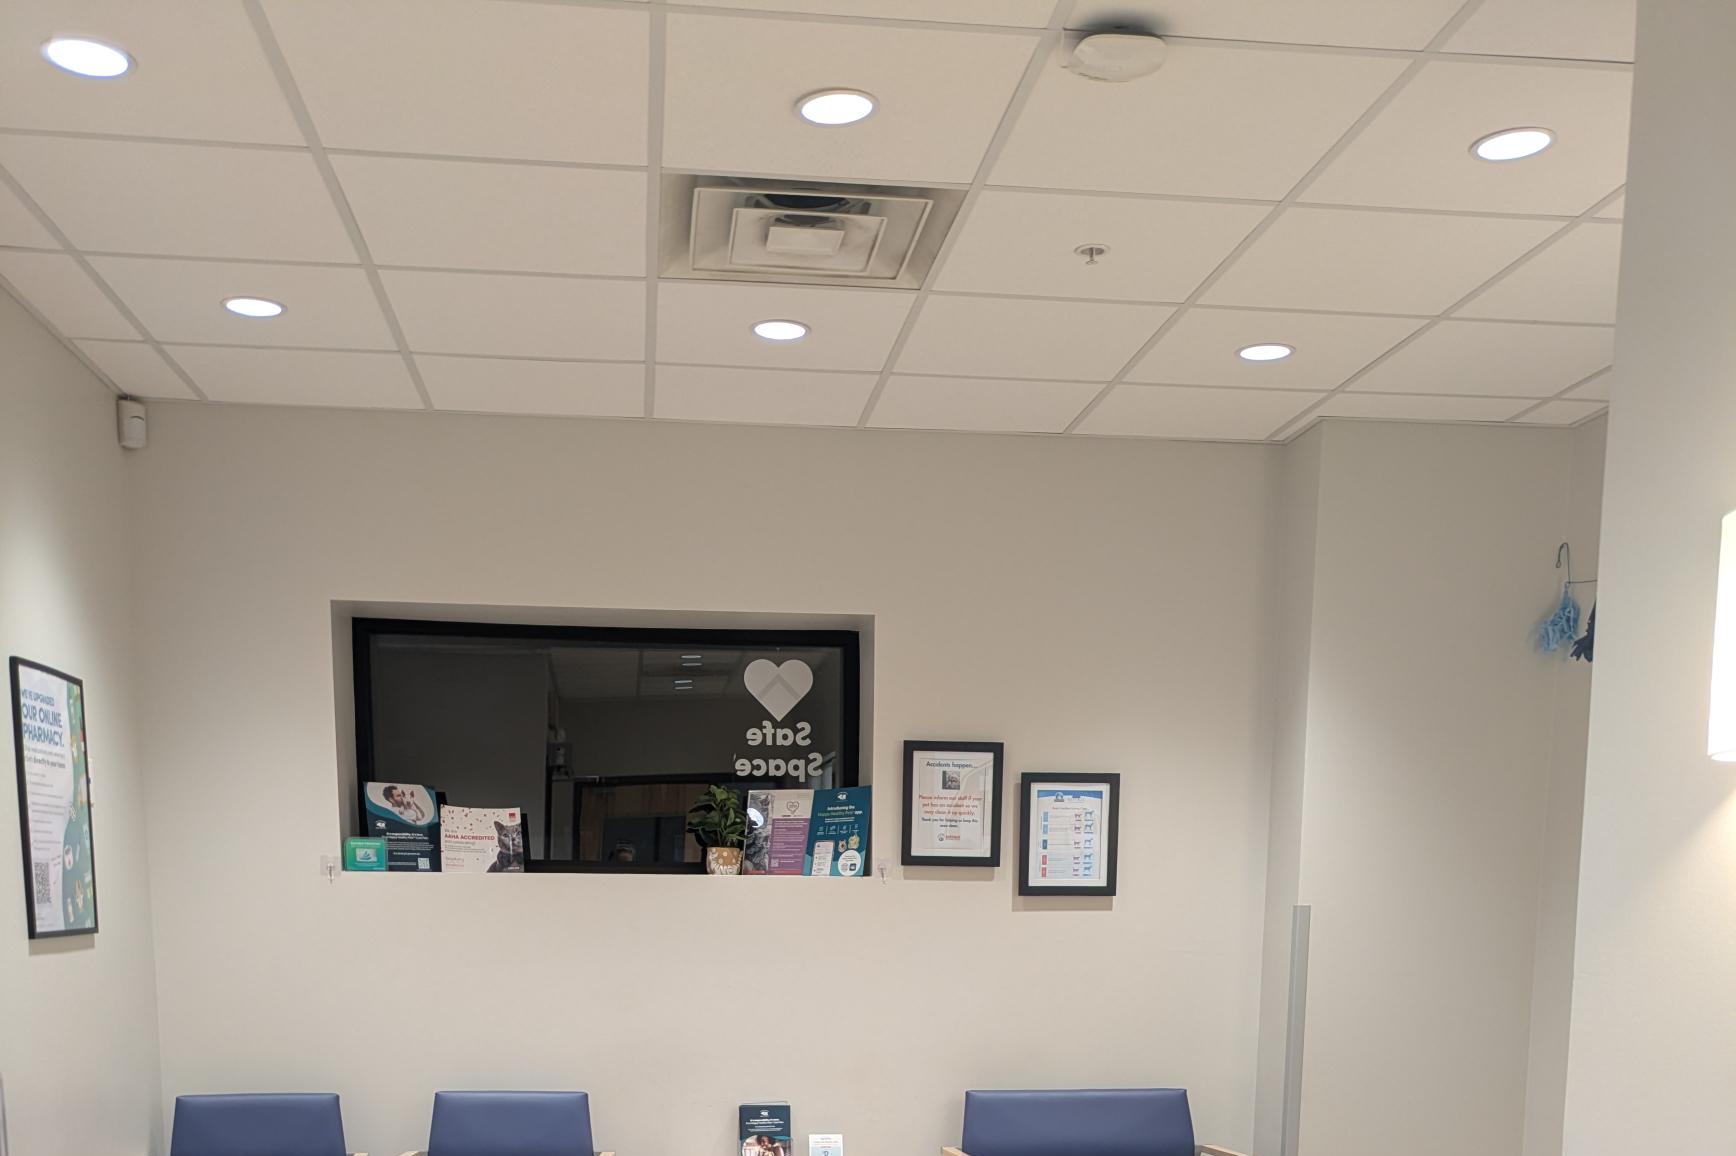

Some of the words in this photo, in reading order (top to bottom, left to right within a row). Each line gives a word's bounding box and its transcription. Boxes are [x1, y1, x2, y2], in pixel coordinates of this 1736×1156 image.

[22, 703, 38, 721] OUR
[38, 707, 63, 729] ONLINE
[22, 722, 65, 748] PHARMACY.
[926, 760, 951, 768] Accidents
